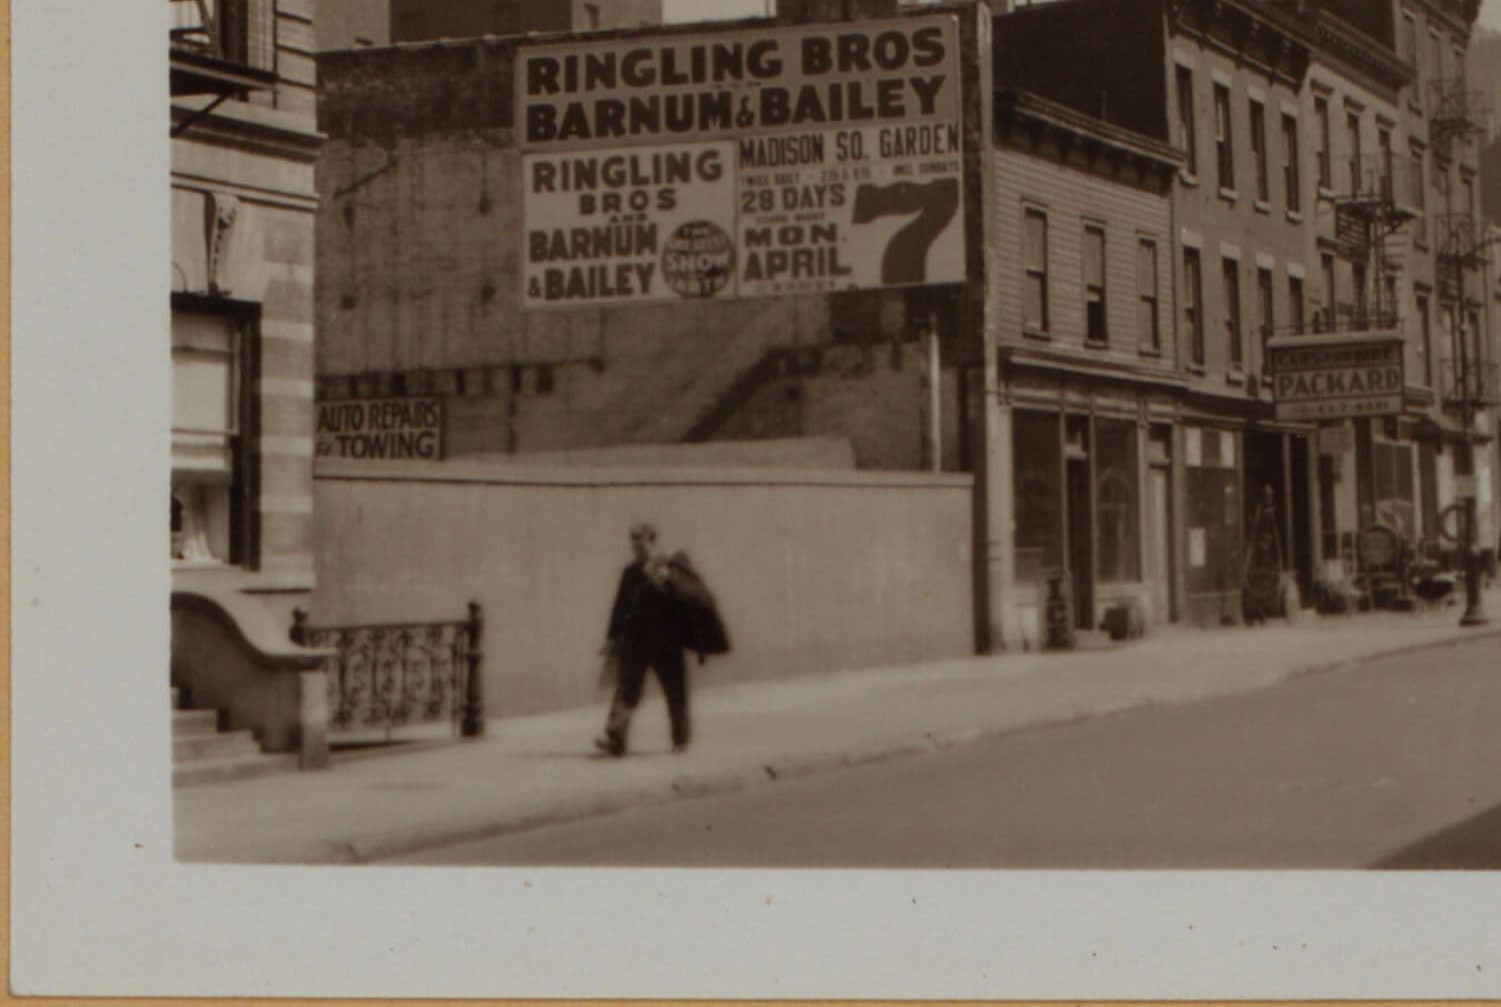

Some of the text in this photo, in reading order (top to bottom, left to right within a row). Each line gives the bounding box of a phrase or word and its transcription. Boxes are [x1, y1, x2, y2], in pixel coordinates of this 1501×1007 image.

[527, 28, 946, 95] RINGLING BROS
[527, 90, 733, 143] BARNUM
[760, 77, 947, 126] BAILEY
[739, 134, 824, 168] MADISON
[879, 121, 960, 158] GARDEN
[532, 149, 723, 193] RINGLING
[579, 188, 677, 215] BROS
[741, 183, 846, 213] 28 DAYS
[529, 222, 658, 262] BARNUM
[852, 177, 960, 285] 7
[545, 262, 656, 300] BAILEY
[743, 246, 852, 281] APRIL
[1279, 369, 1400, 397] PACKARD
[318, 404, 364, 432] AUTO
[336, 432, 436, 458] TOWING
